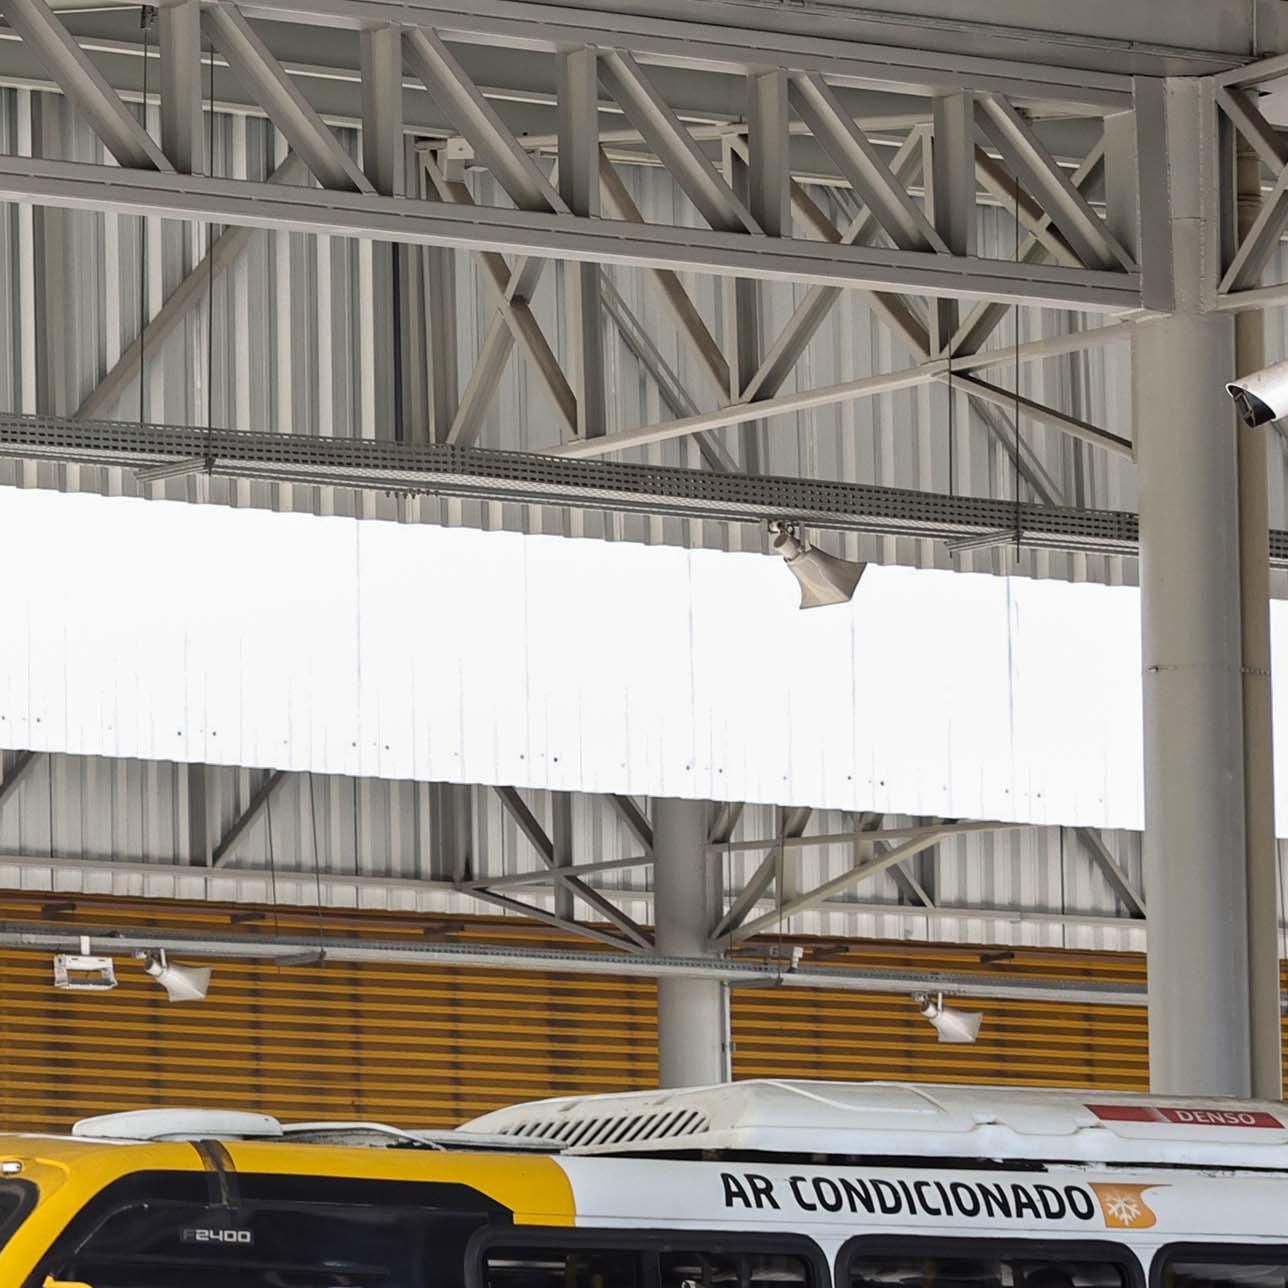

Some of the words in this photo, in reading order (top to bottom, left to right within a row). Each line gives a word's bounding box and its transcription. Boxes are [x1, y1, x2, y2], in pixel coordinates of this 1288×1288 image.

[1178, 1109, 1257, 1127] DENSO
[720, 1172, 781, 1210] AR
[790, 1174, 1096, 1221] CONDICIONADO
